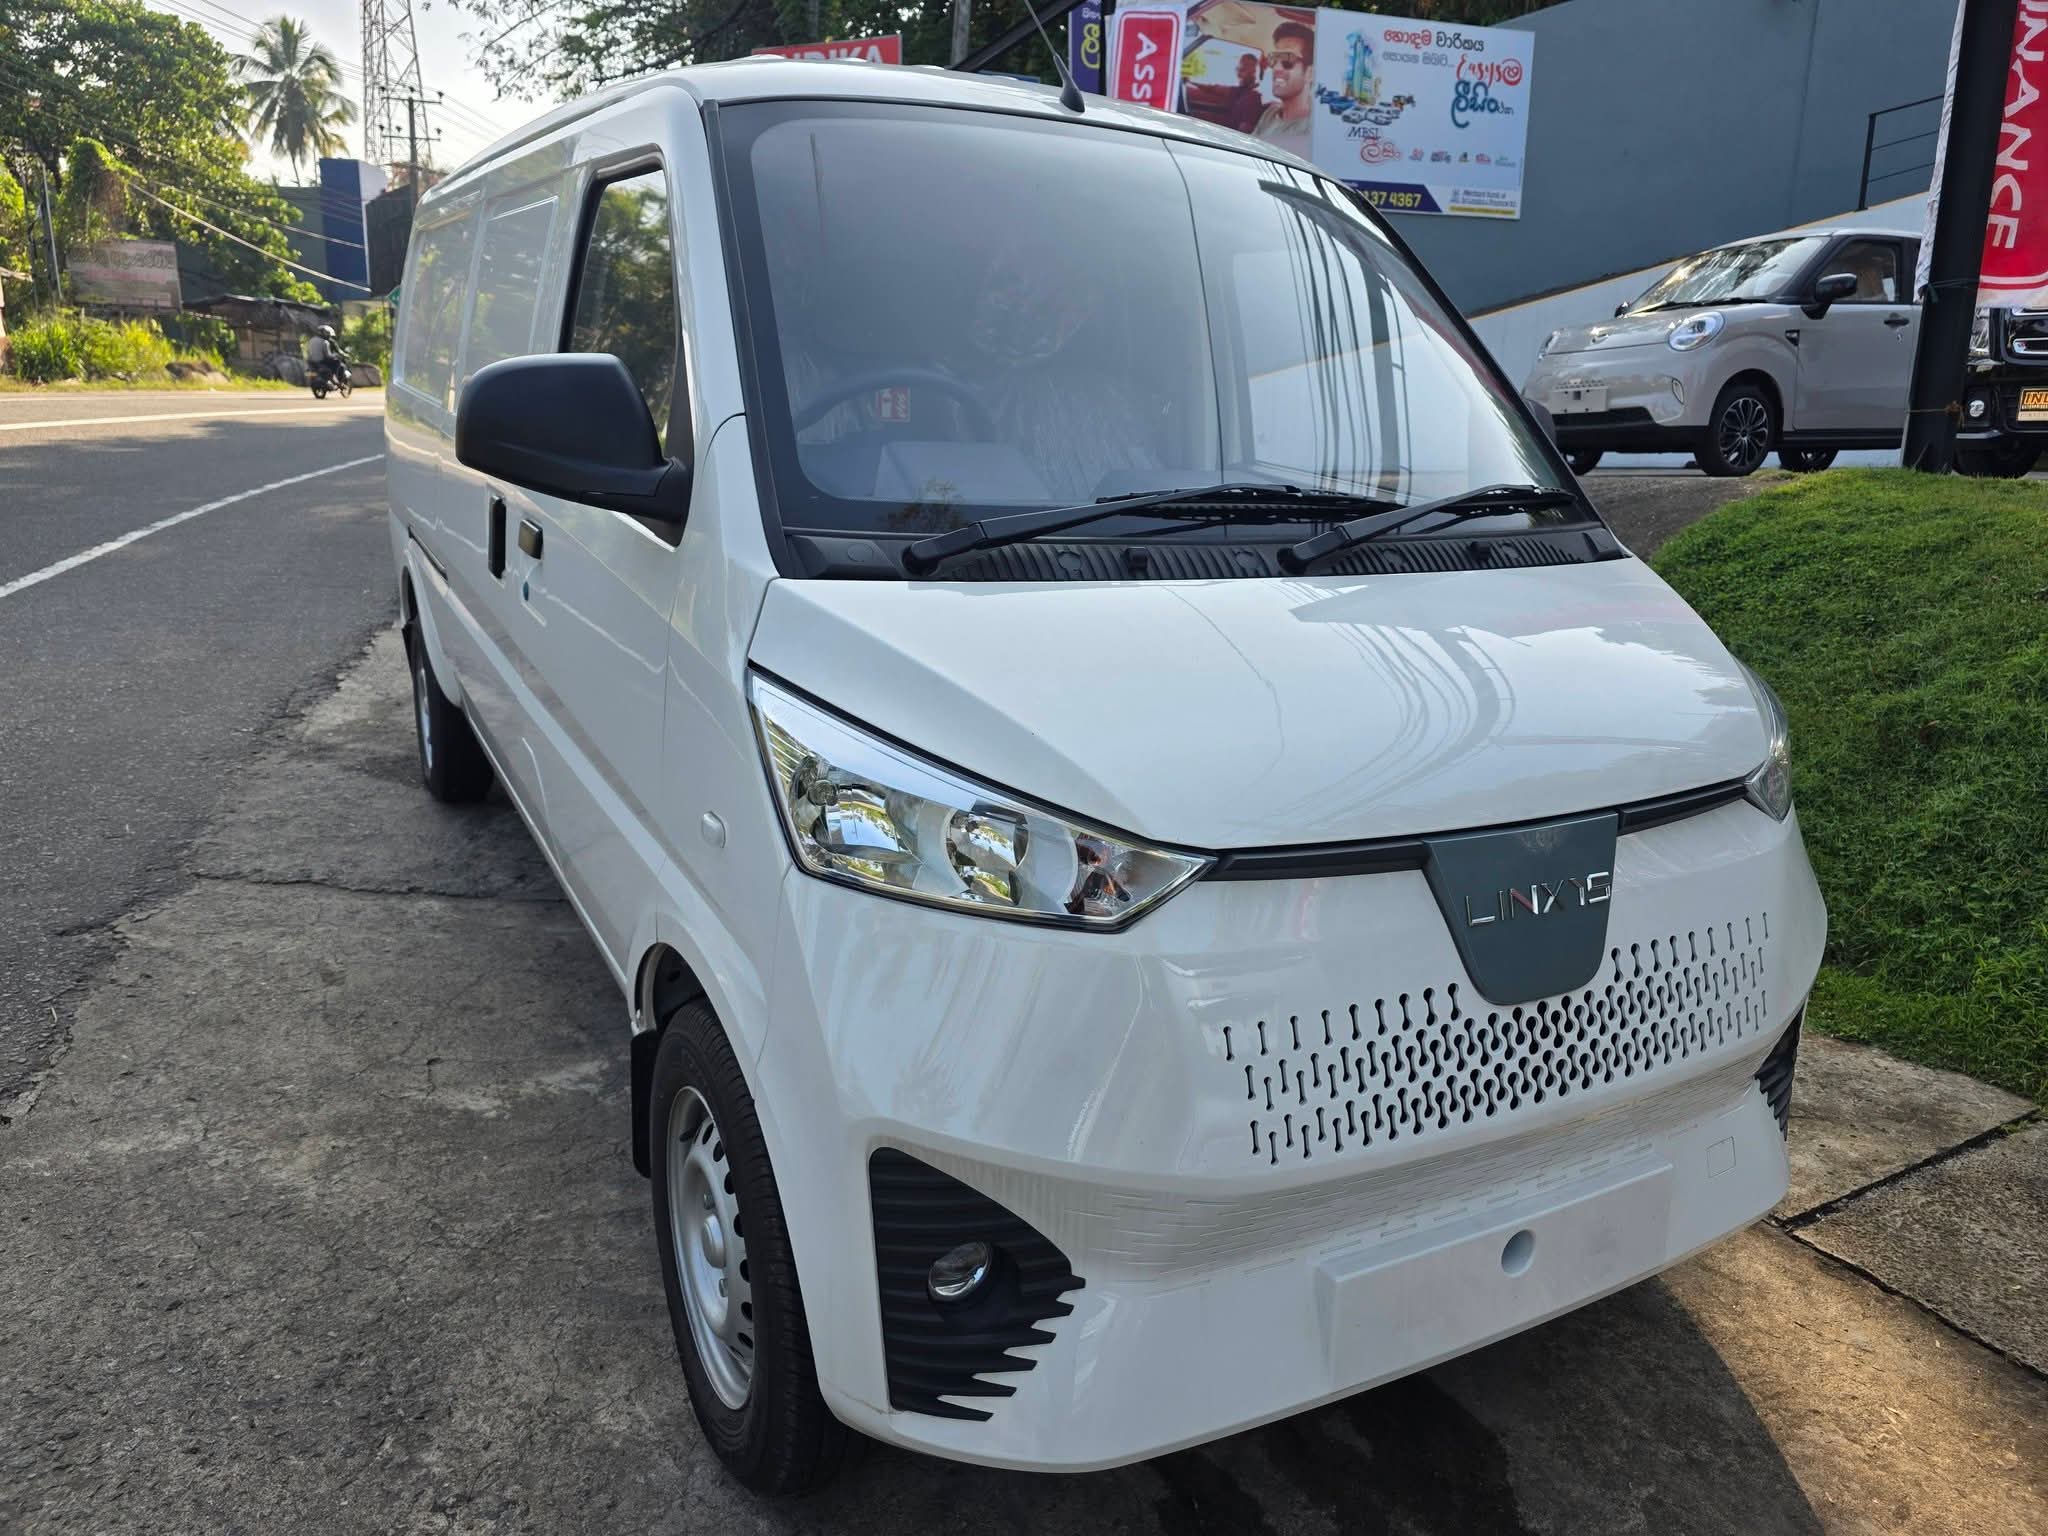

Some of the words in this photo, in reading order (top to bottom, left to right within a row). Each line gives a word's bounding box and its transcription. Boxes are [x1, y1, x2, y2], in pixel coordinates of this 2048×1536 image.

[1131, 31, 1158, 106] ASS
[1389, 191, 1422, 208] 4367
[1465, 871, 1611, 927] LINXYS
